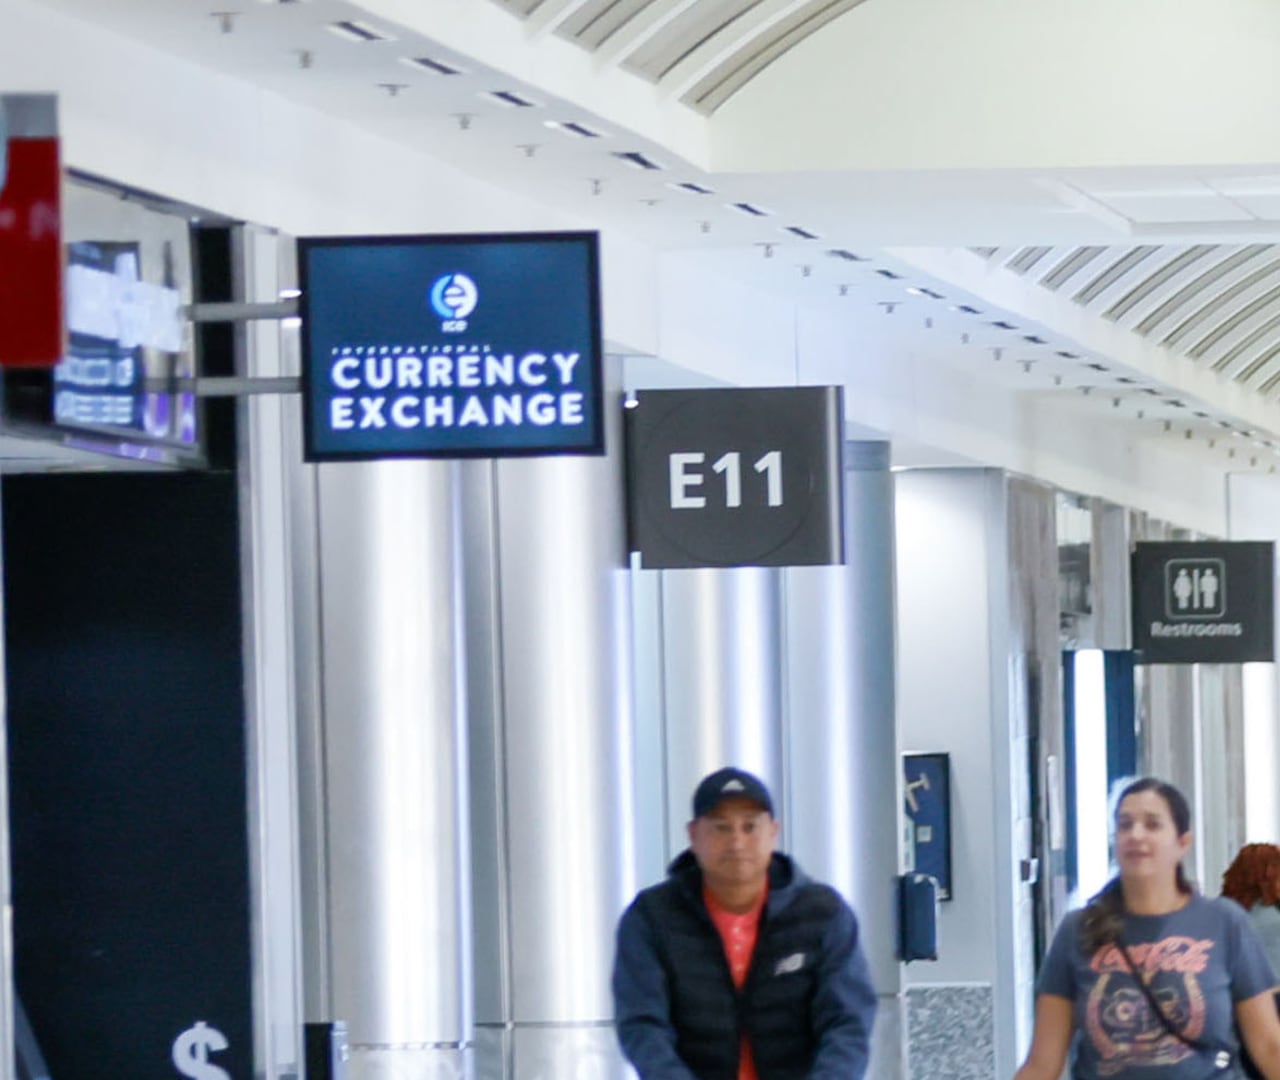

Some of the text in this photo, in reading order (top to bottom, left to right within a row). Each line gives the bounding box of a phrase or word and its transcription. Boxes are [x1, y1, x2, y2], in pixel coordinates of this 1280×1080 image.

[331, 353, 580, 390] CURRENCY
[331, 392, 584, 429] EXCHANGE
[670, 451, 782, 509] E11
[1150, 621, 1243, 638] Restrooms
